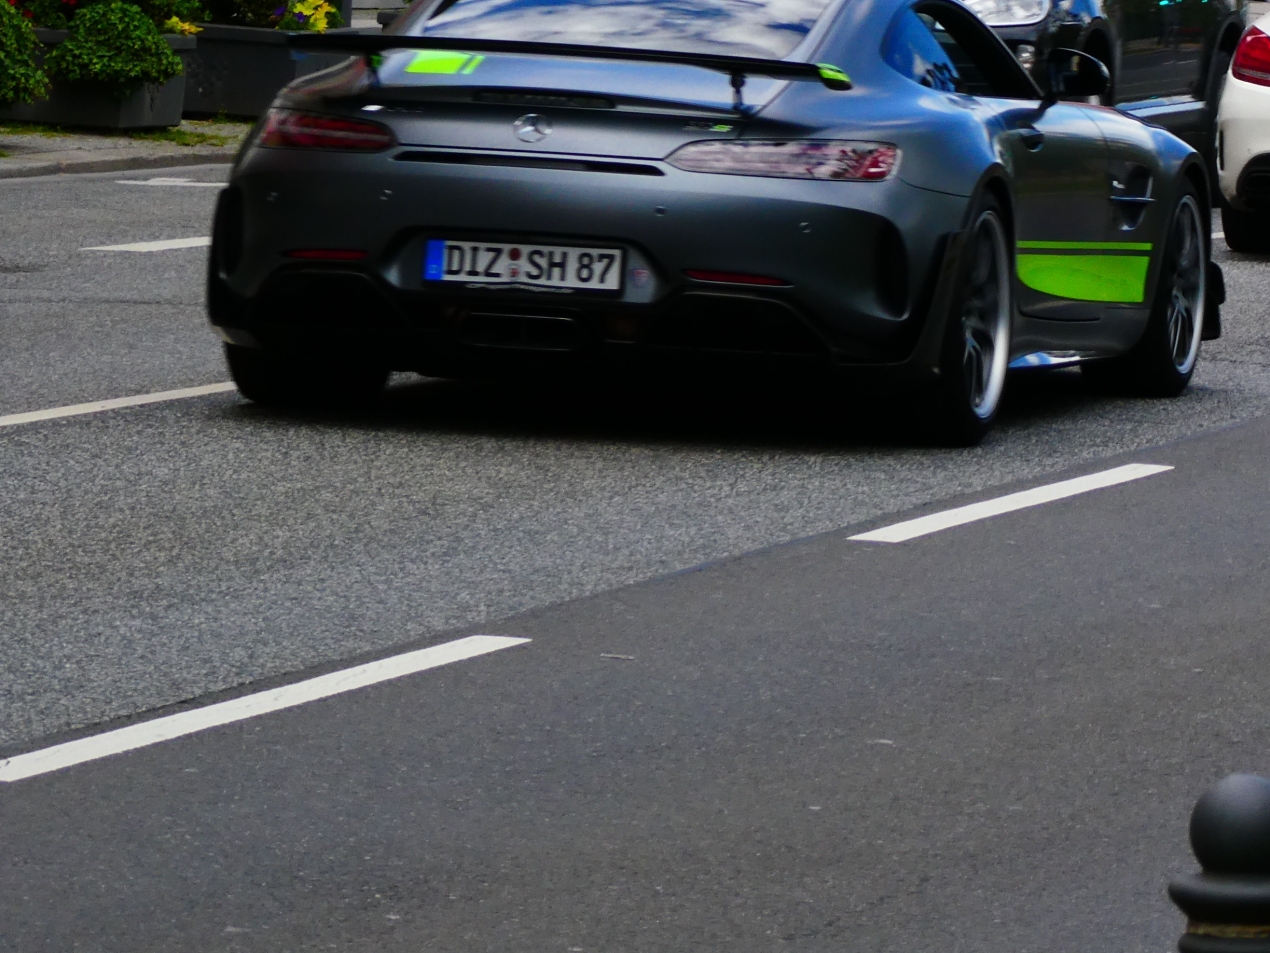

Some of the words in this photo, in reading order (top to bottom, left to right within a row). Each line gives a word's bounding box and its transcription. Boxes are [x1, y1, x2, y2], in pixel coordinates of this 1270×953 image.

[446, 244, 504, 278] DIZ
[525, 249, 568, 281] SH
[576, 252, 616, 284] 87
